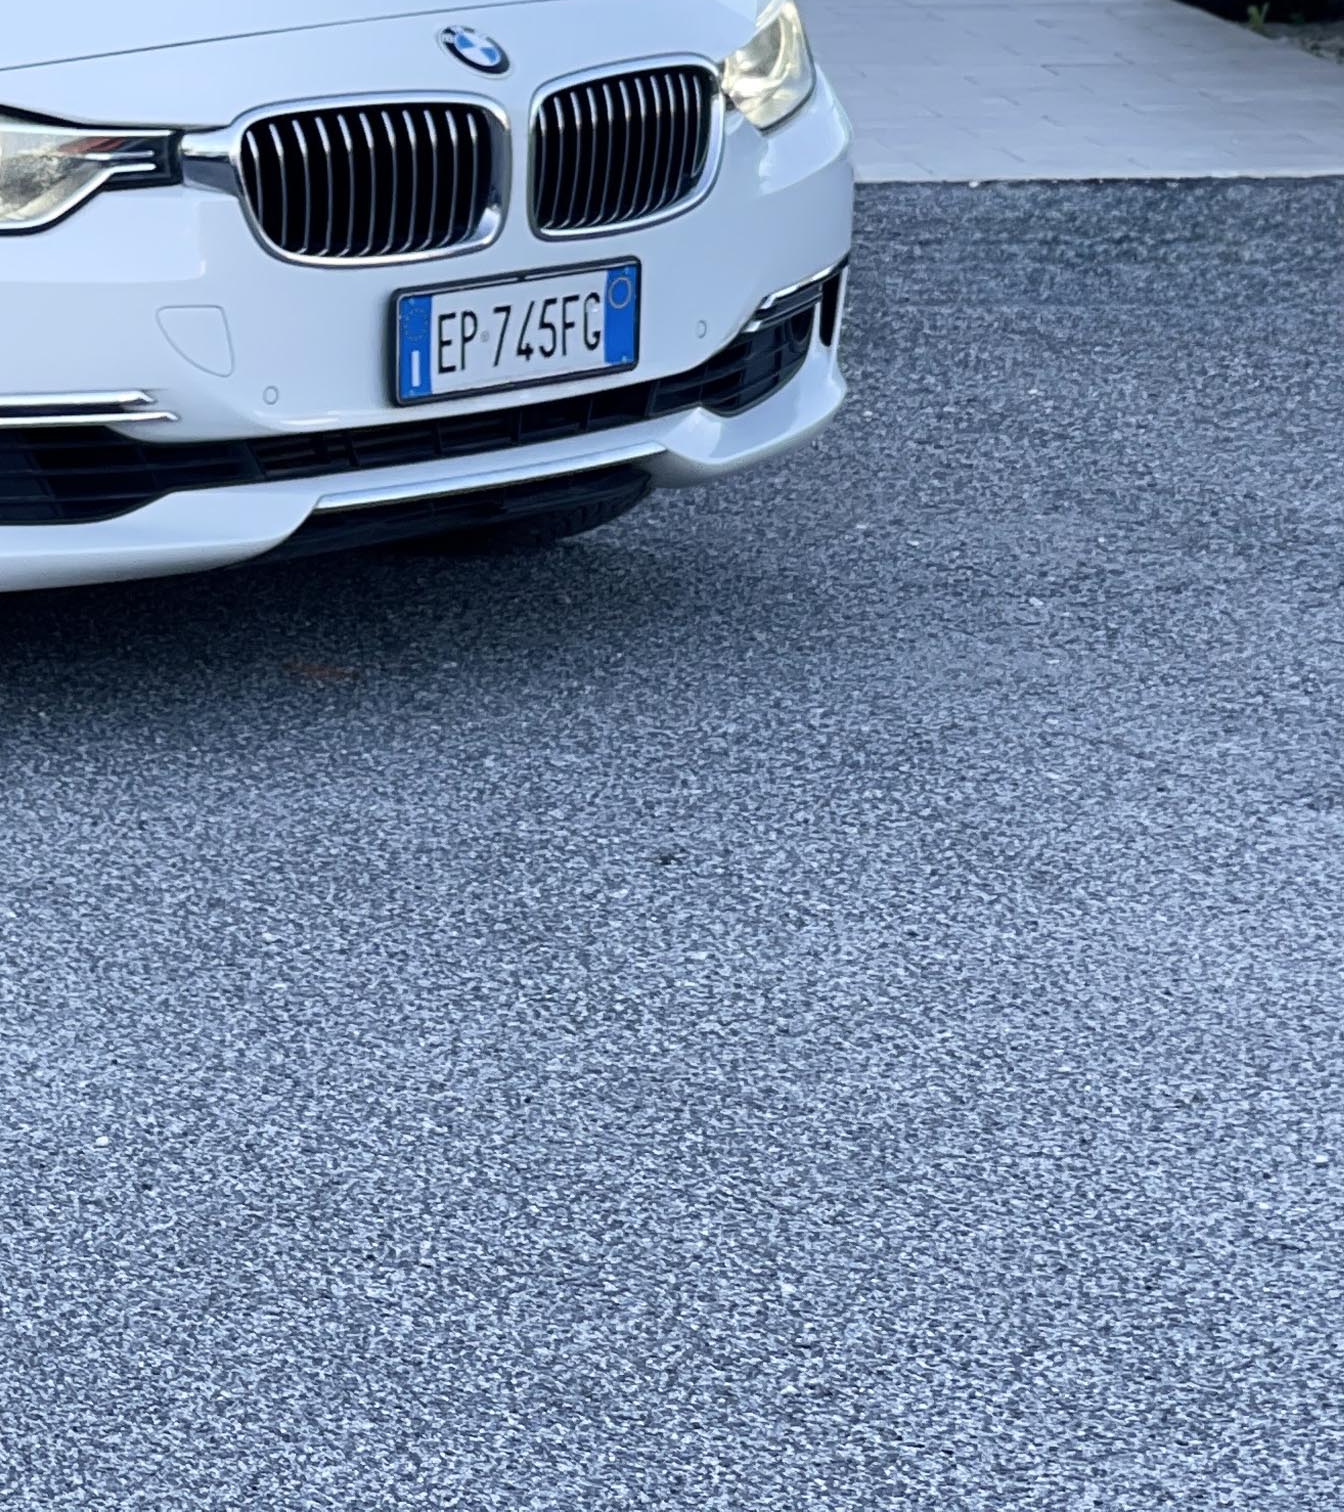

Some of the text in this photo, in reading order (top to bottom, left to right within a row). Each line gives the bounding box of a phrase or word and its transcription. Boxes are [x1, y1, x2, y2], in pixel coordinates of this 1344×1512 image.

[437, 291, 601, 375] EP 745FG
[411, 349, 421, 388] I
